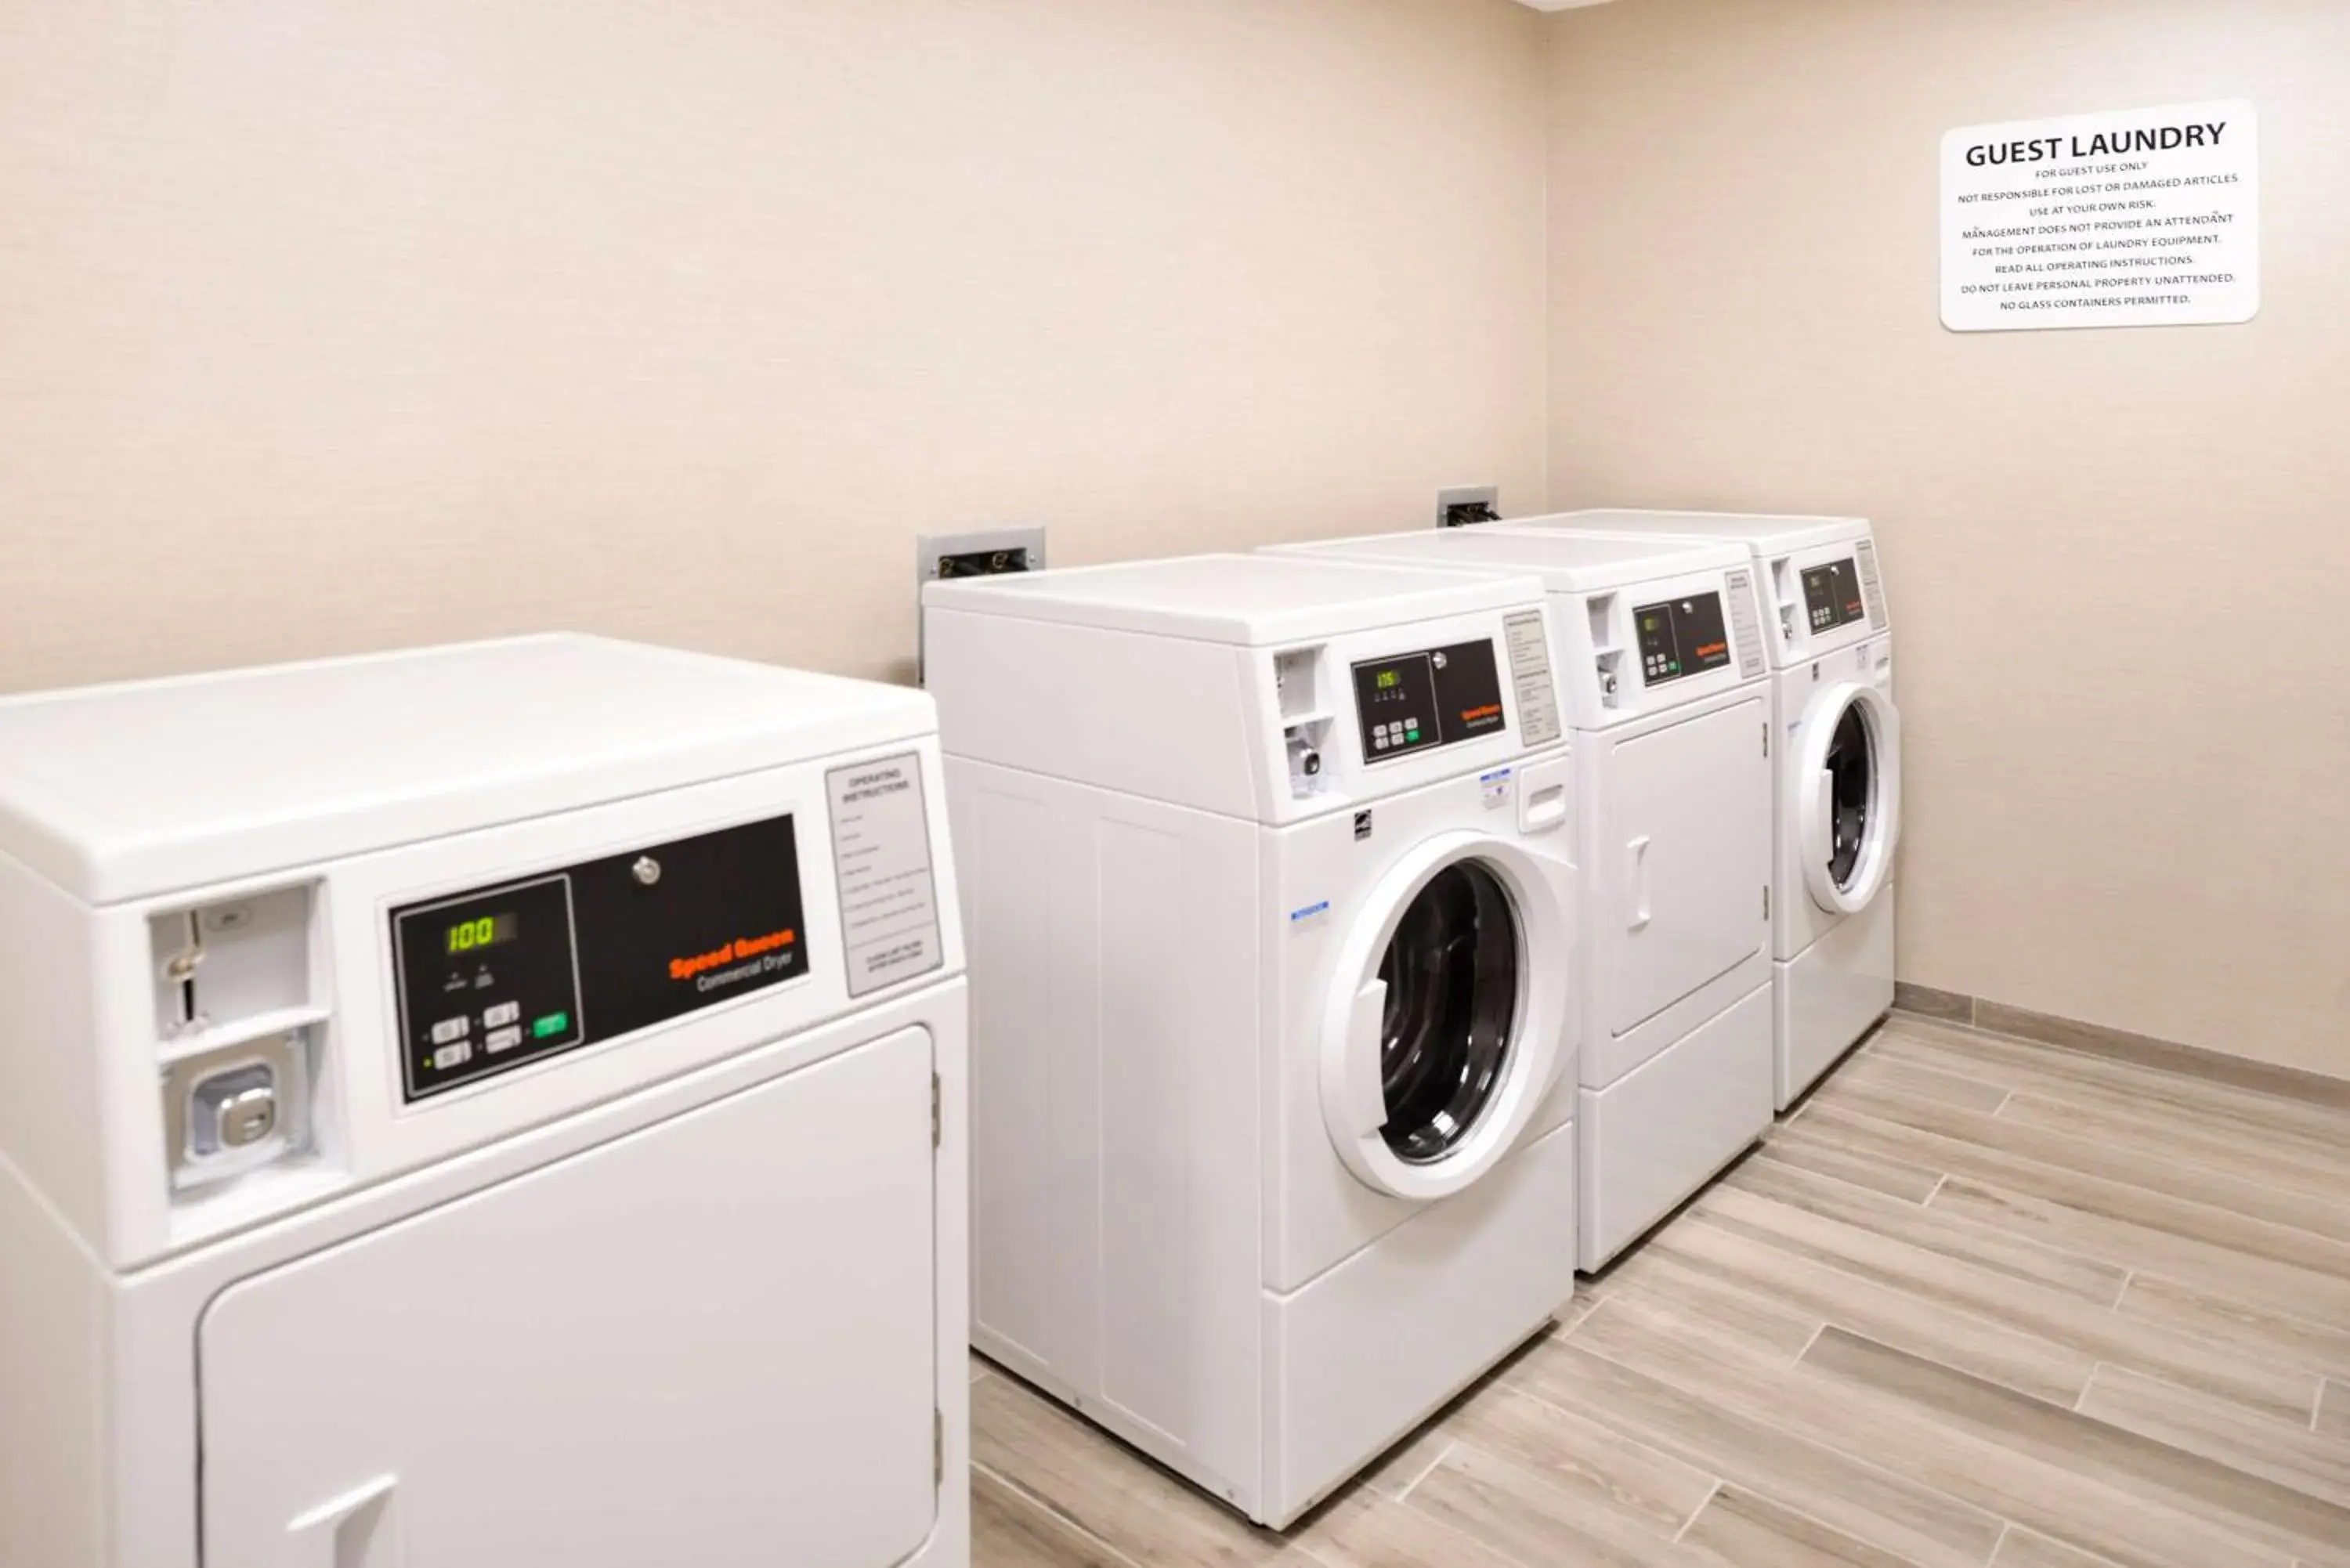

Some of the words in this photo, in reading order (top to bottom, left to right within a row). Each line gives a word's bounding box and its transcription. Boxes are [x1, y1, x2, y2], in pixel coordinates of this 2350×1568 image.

[1965, 137, 2063, 166] GUEST
[2072, 121, 2226, 157] LAUNDRY
[2036, 169, 2057, 179] FOR
[2058, 166, 2093, 177] GUEST
[2096, 164, 2117, 173] USE
[2120, 161, 2148, 172] ONLY
[1958, 193, 1979, 204] NOT
[1981, 188, 2049, 201] RESPONSIBLE
[2052, 187, 2073, 197] FOR
[2076, 184, 2102, 195] LOST
[2105, 182, 2120, 192] OR
[2124, 177, 2181, 191] DAMAGED
[2030, 206, 2049, 216] USE
[2052, 205, 2064, 215] AT
[2066, 203, 2097, 214] YOUR
[2099, 202, 2125, 211] OWN
[2128, 200, 2156, 209] RISK.
[1961, 226, 2035, 239] MANAGEMENT
[2038, 224, 2067, 234] DOES
[2069, 223, 2091, 233] NOT
[2094, 219, 2143, 230] PROVIDE
[2146, 219, 2162, 228] AN
[2164, 214, 2234, 226] ATTENDANT
[1972, 247, 1993, 257] FOR
[1995, 246, 2014, 255] THE
[2016, 243, 2077, 255] OPERATION
[2079, 242, 2093, 251] OF
[2096, 238, 2149, 250] LAUNDRY
[2152, 234, 2222, 247] EQUIPMENT.
[1995, 265, 2023, 273] READ
[2025, 263, 2044, 272] ALL
[2046, 259, 2107, 271] OPERATING
[2110, 255, 2196, 268] INSTRUCTIONS.
[1961, 284, 1977, 294] DO
[1979, 284, 2000, 293] NOT
[2002, 282, 2034, 292] LEAVE
[2036, 279, 2092, 291] PERSONAL
[2095, 276, 2155, 287] PROPERTY
[2155, 273, 2236, 285] UNATTENDED.
[2000, 301, 2016, 310] NO
[2018, 300, 2052, 309] GLASS
[2053, 297, 2122, 309] CONTAINERS
[2124, 294, 2191, 305] PERMITTED.
[448, 916, 494, 952] 100
[669, 942, 732, 979] Speed
[733, 928, 794, 959] Queen
[696, 959, 761, 993] Commercial
[762, 951, 793, 971] Dryer
